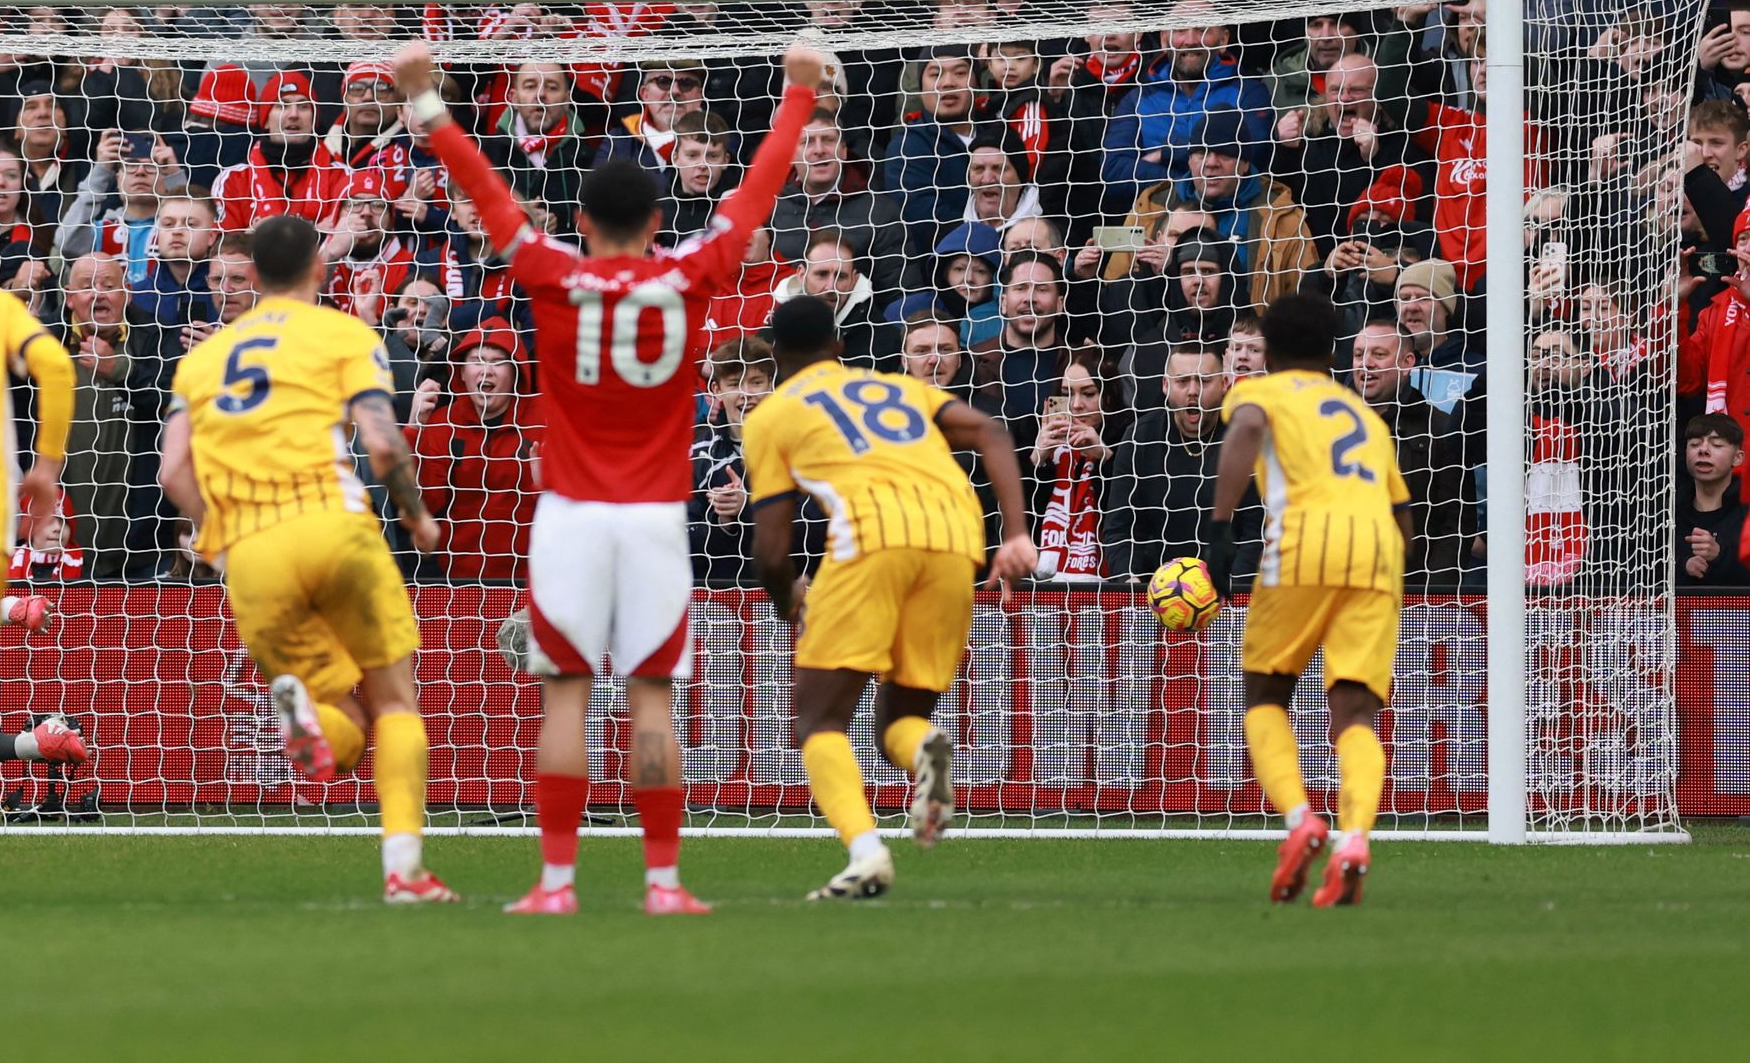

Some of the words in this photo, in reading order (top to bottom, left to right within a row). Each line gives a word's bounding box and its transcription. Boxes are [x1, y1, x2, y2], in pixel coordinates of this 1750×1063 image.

[215, 336, 279, 413] 5
[568, 282, 687, 388] 10
[804, 380, 926, 455] 18
[1319, 399, 1375, 482] 2
